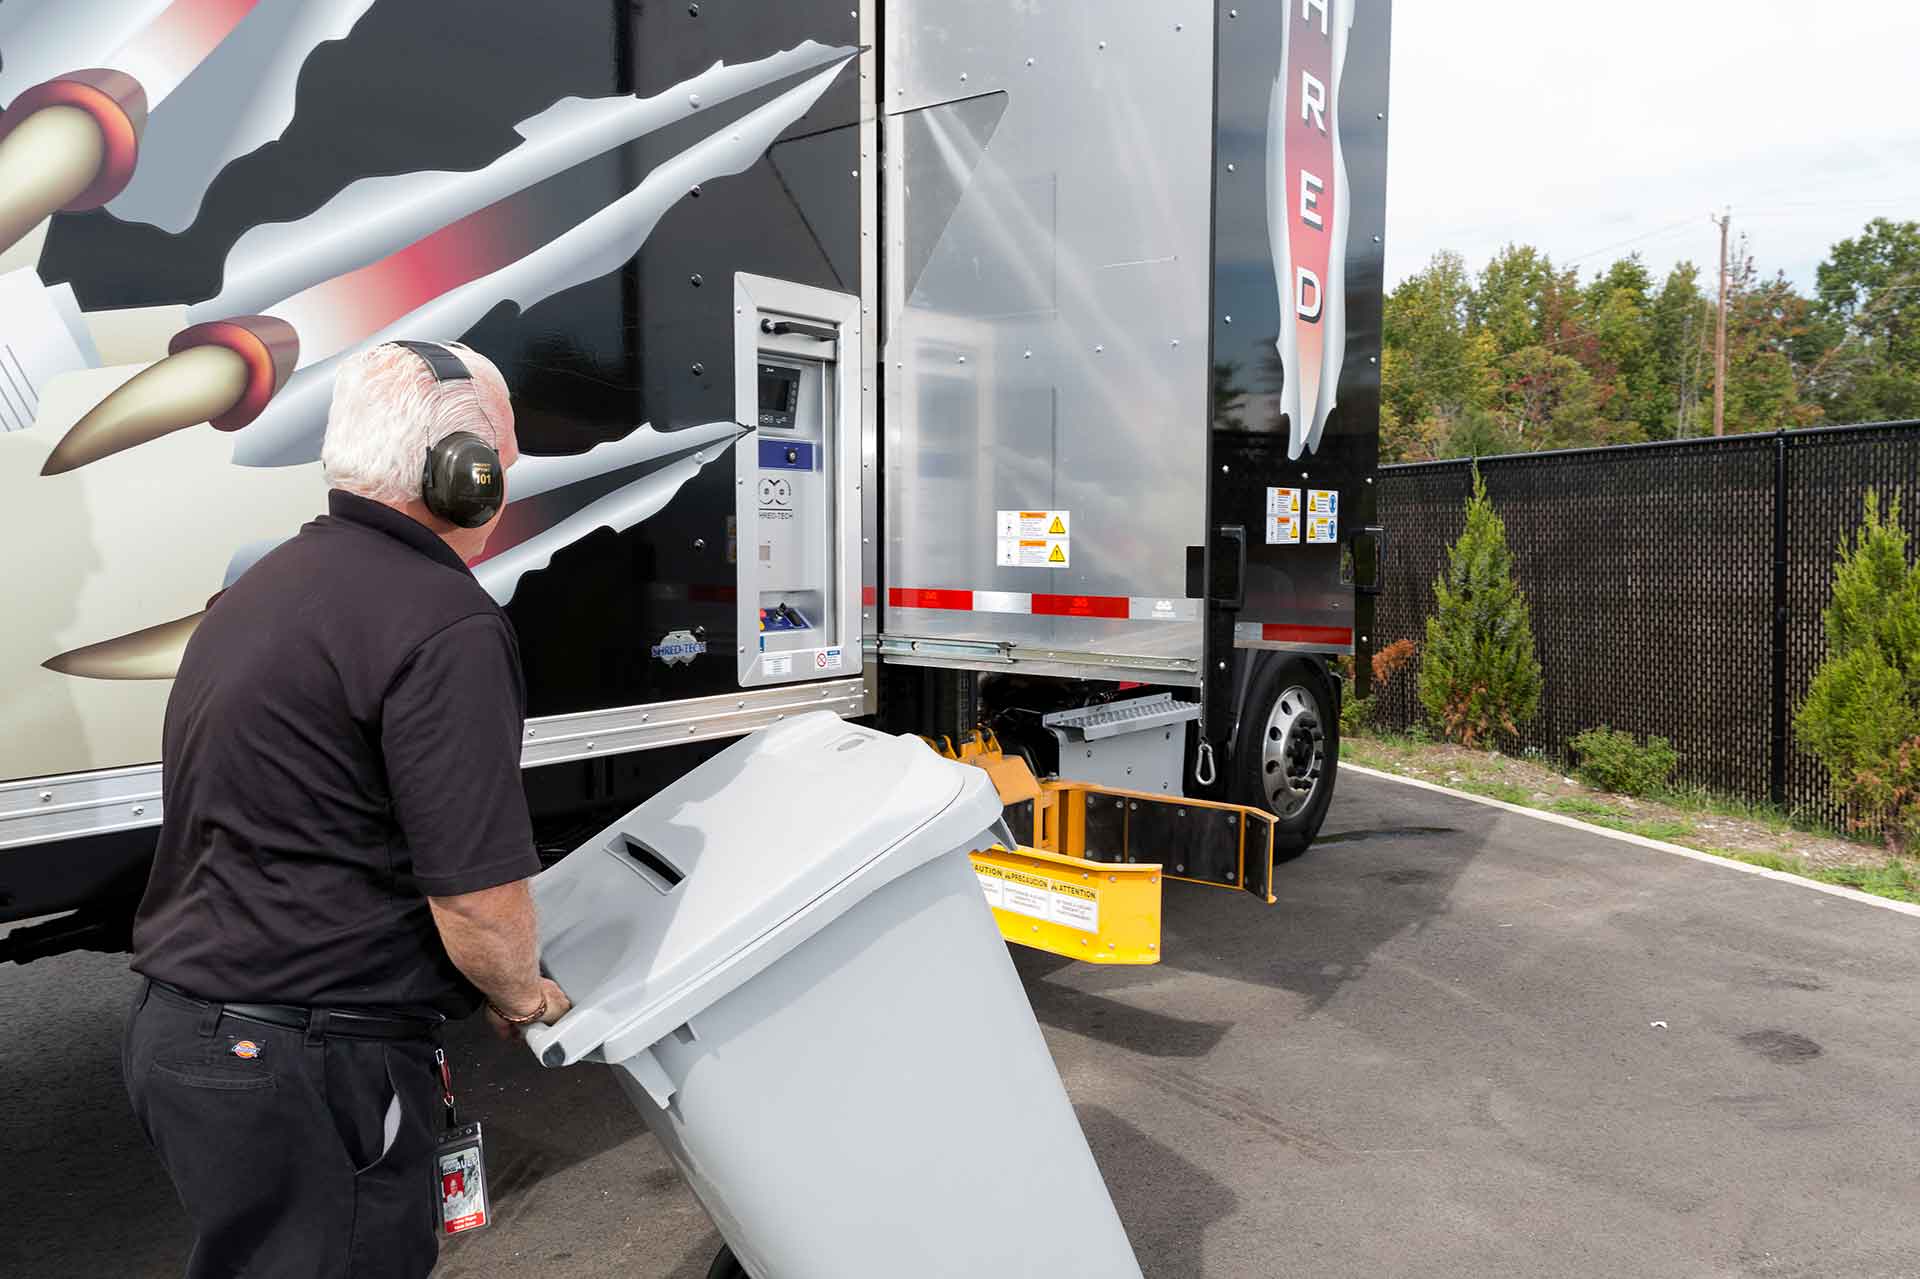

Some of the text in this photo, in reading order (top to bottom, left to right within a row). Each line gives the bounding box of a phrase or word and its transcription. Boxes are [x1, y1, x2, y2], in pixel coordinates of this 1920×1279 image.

[476, 472, 491, 484] 101
[759, 511, 793, 520] HRED-TECH
[974, 864, 1003, 877] AUTION
[1058, 884, 1096, 899] ATTENTION
